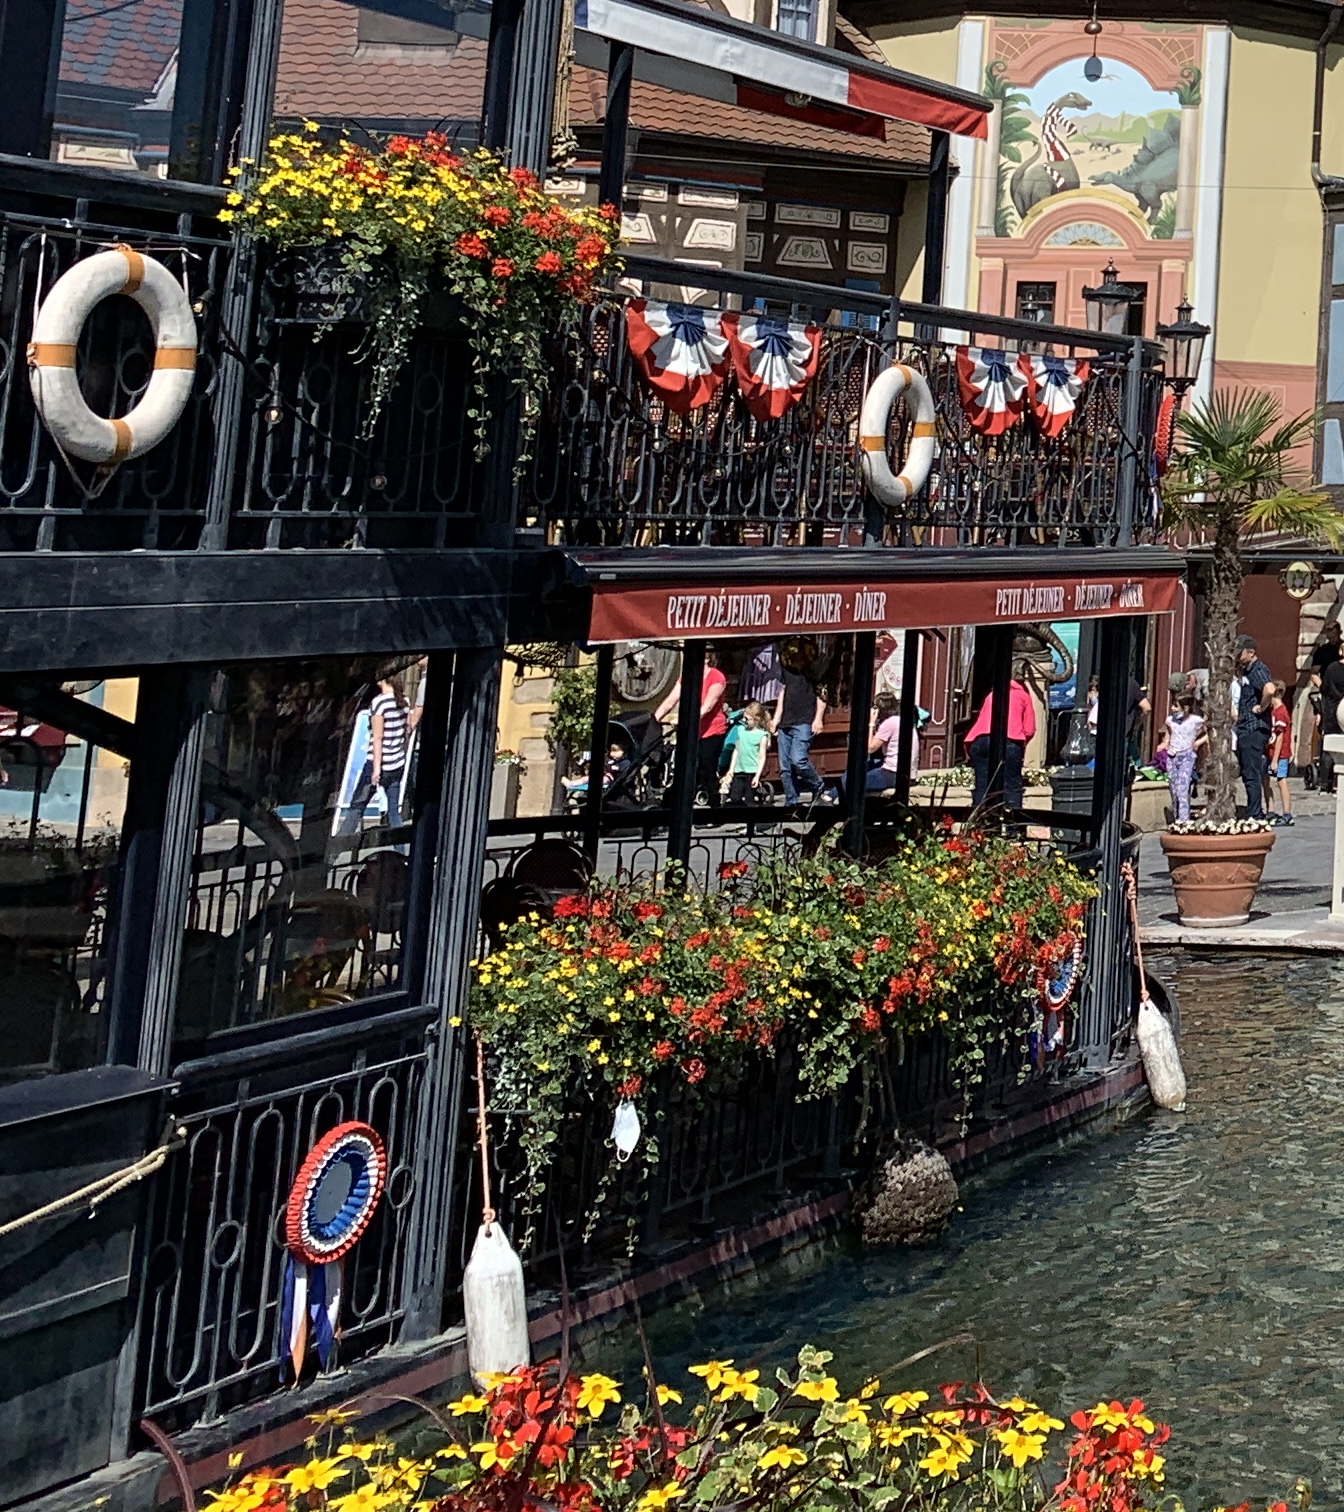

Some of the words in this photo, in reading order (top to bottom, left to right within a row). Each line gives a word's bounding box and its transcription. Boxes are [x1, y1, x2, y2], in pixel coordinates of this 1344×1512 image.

[667, 595, 707, 629] PETIT
[705, 588, 771, 628] DÉJEUNER
[784, 586, 842, 625] DÉJEUNER
[853, 586, 887, 622] DÎNER
[995, 588, 1022, 616] PETIT
[1022, 582, 1065, 615] DÉJEUNER
[1074, 580, 1114, 611] DÉJEUNER
